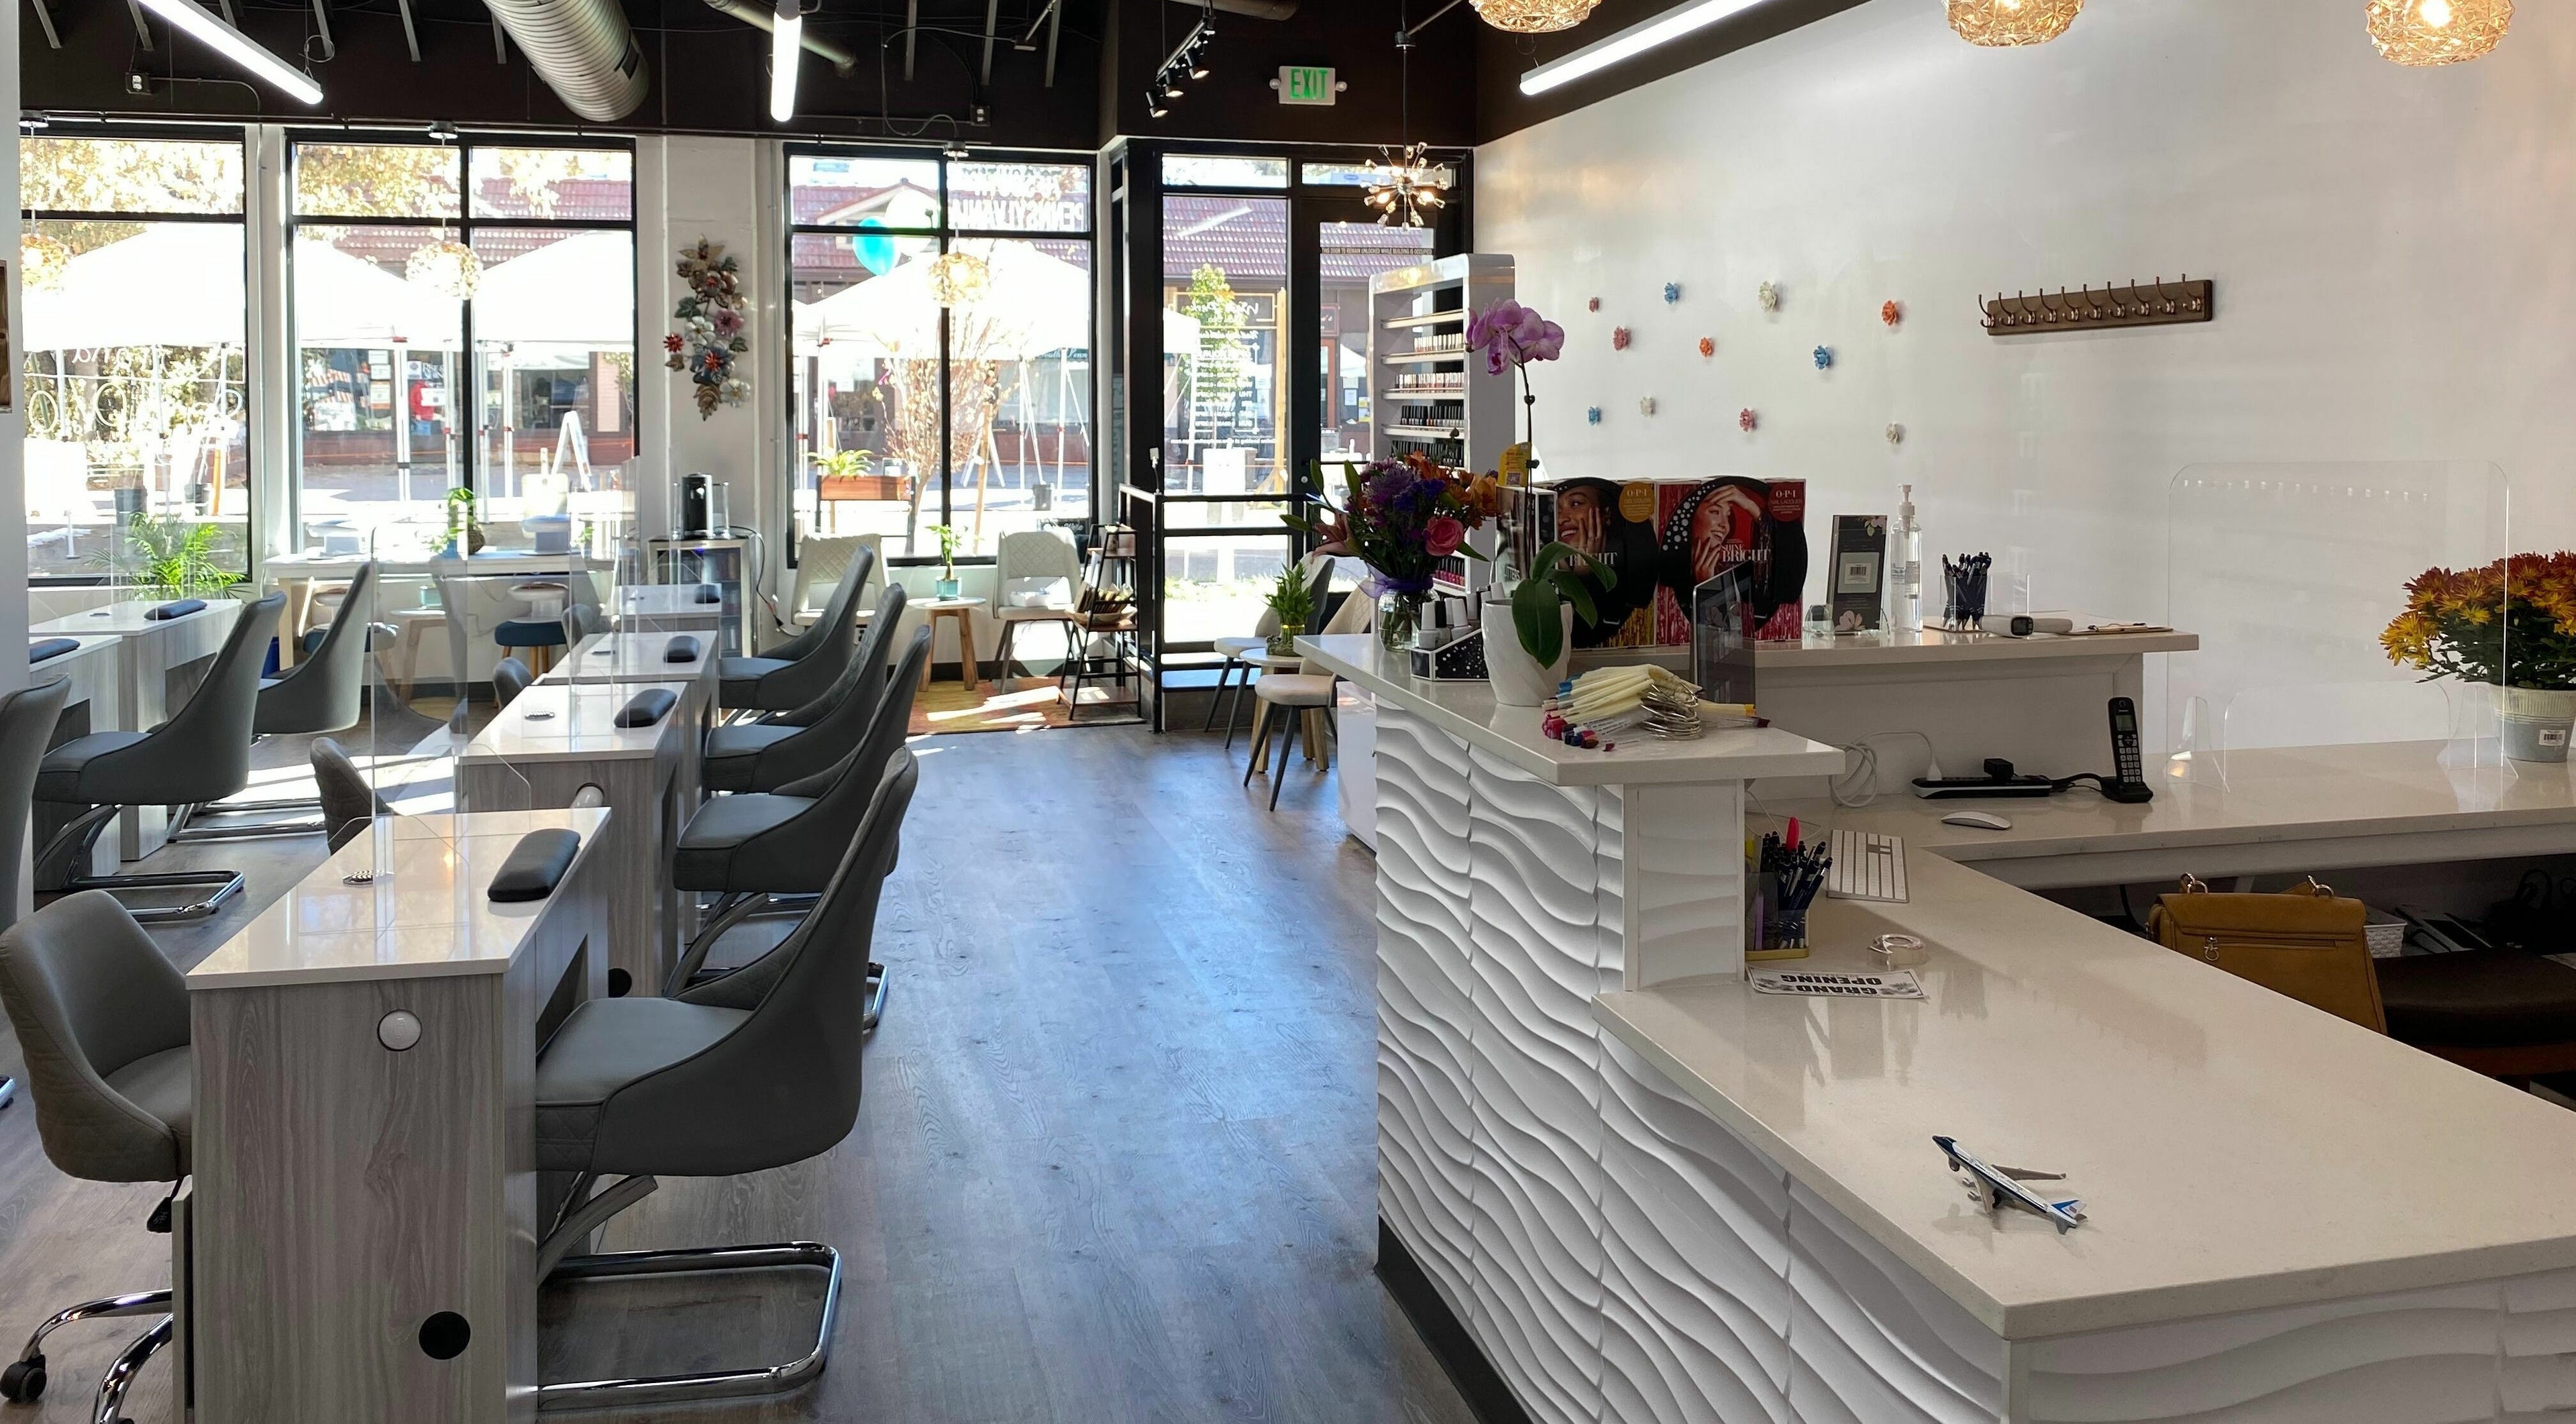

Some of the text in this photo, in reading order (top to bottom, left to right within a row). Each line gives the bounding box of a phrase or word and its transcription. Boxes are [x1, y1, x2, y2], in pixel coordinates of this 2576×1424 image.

[1290, 68, 1328, 99] EXIT
[1721, 549, 1771, 562] BRIGHT
[1780, 974, 1882, 985] OPENING
[1796, 984, 1878, 995] GRAND
